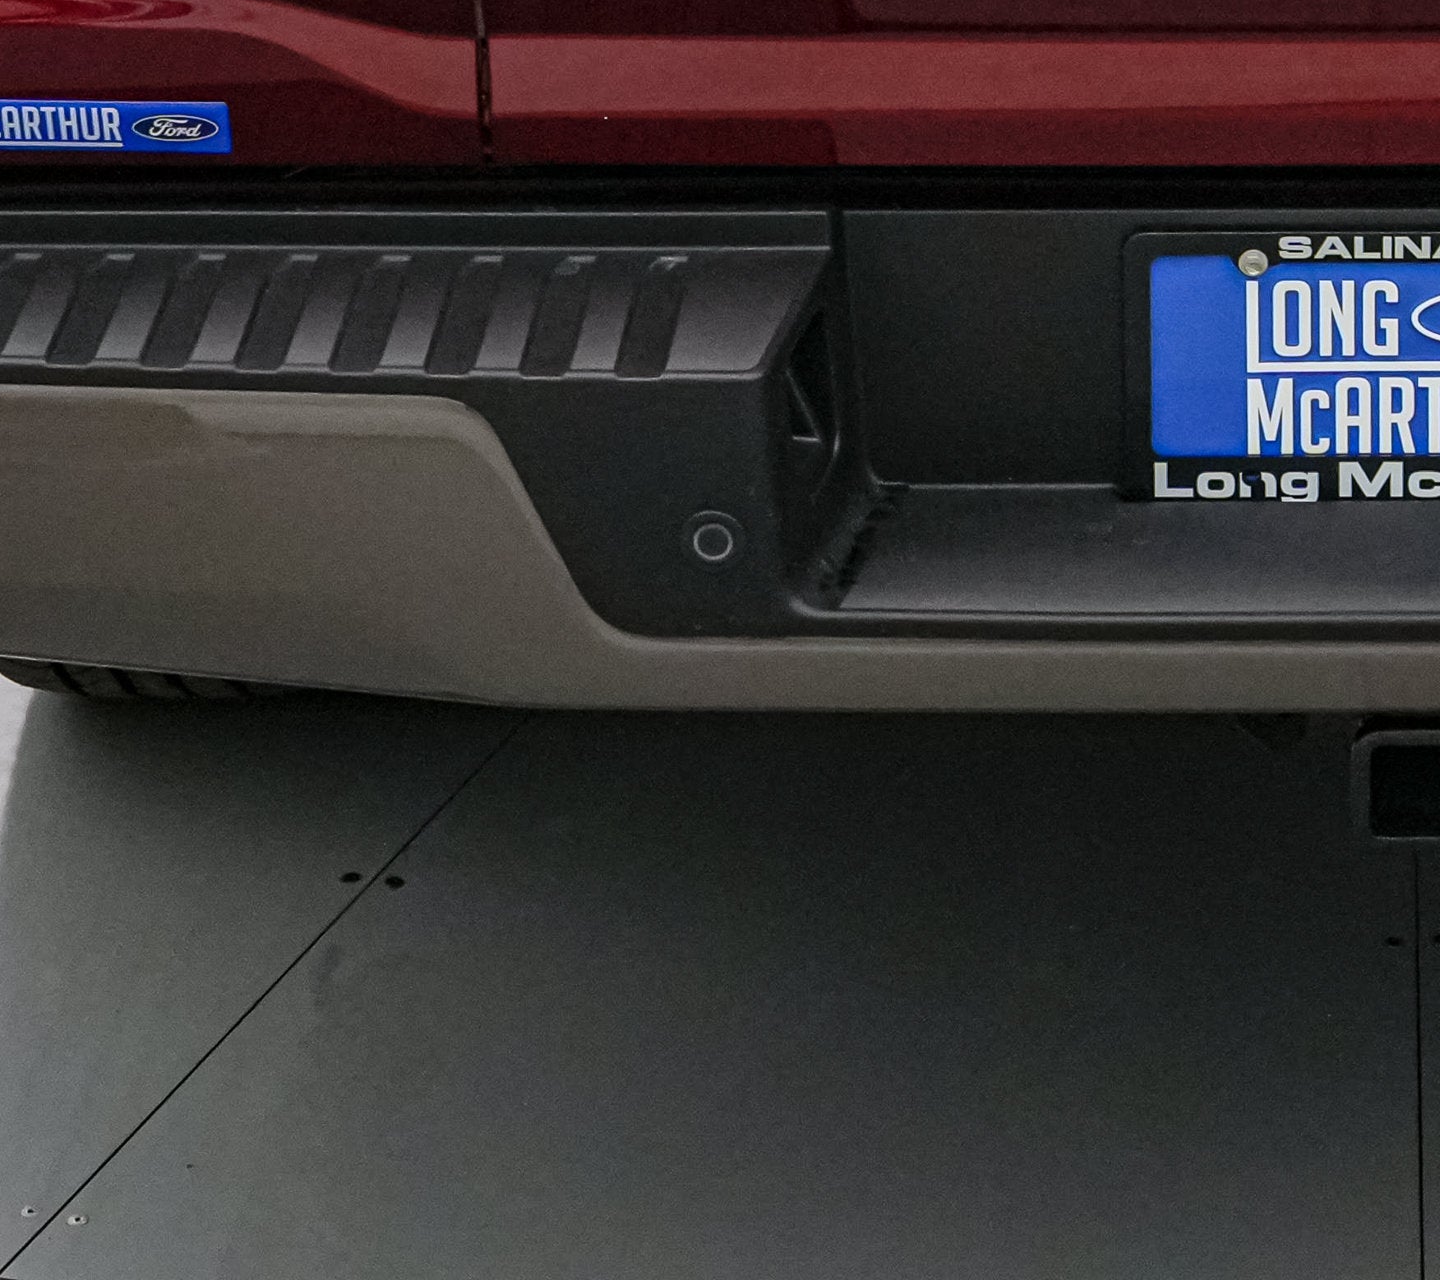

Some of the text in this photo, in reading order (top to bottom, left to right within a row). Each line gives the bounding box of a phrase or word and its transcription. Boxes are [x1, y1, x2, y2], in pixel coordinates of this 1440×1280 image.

[148, 115, 202, 138] Ford
[1245, 279, 1400, 372] LONG
[1153, 460, 1320, 503] Long
